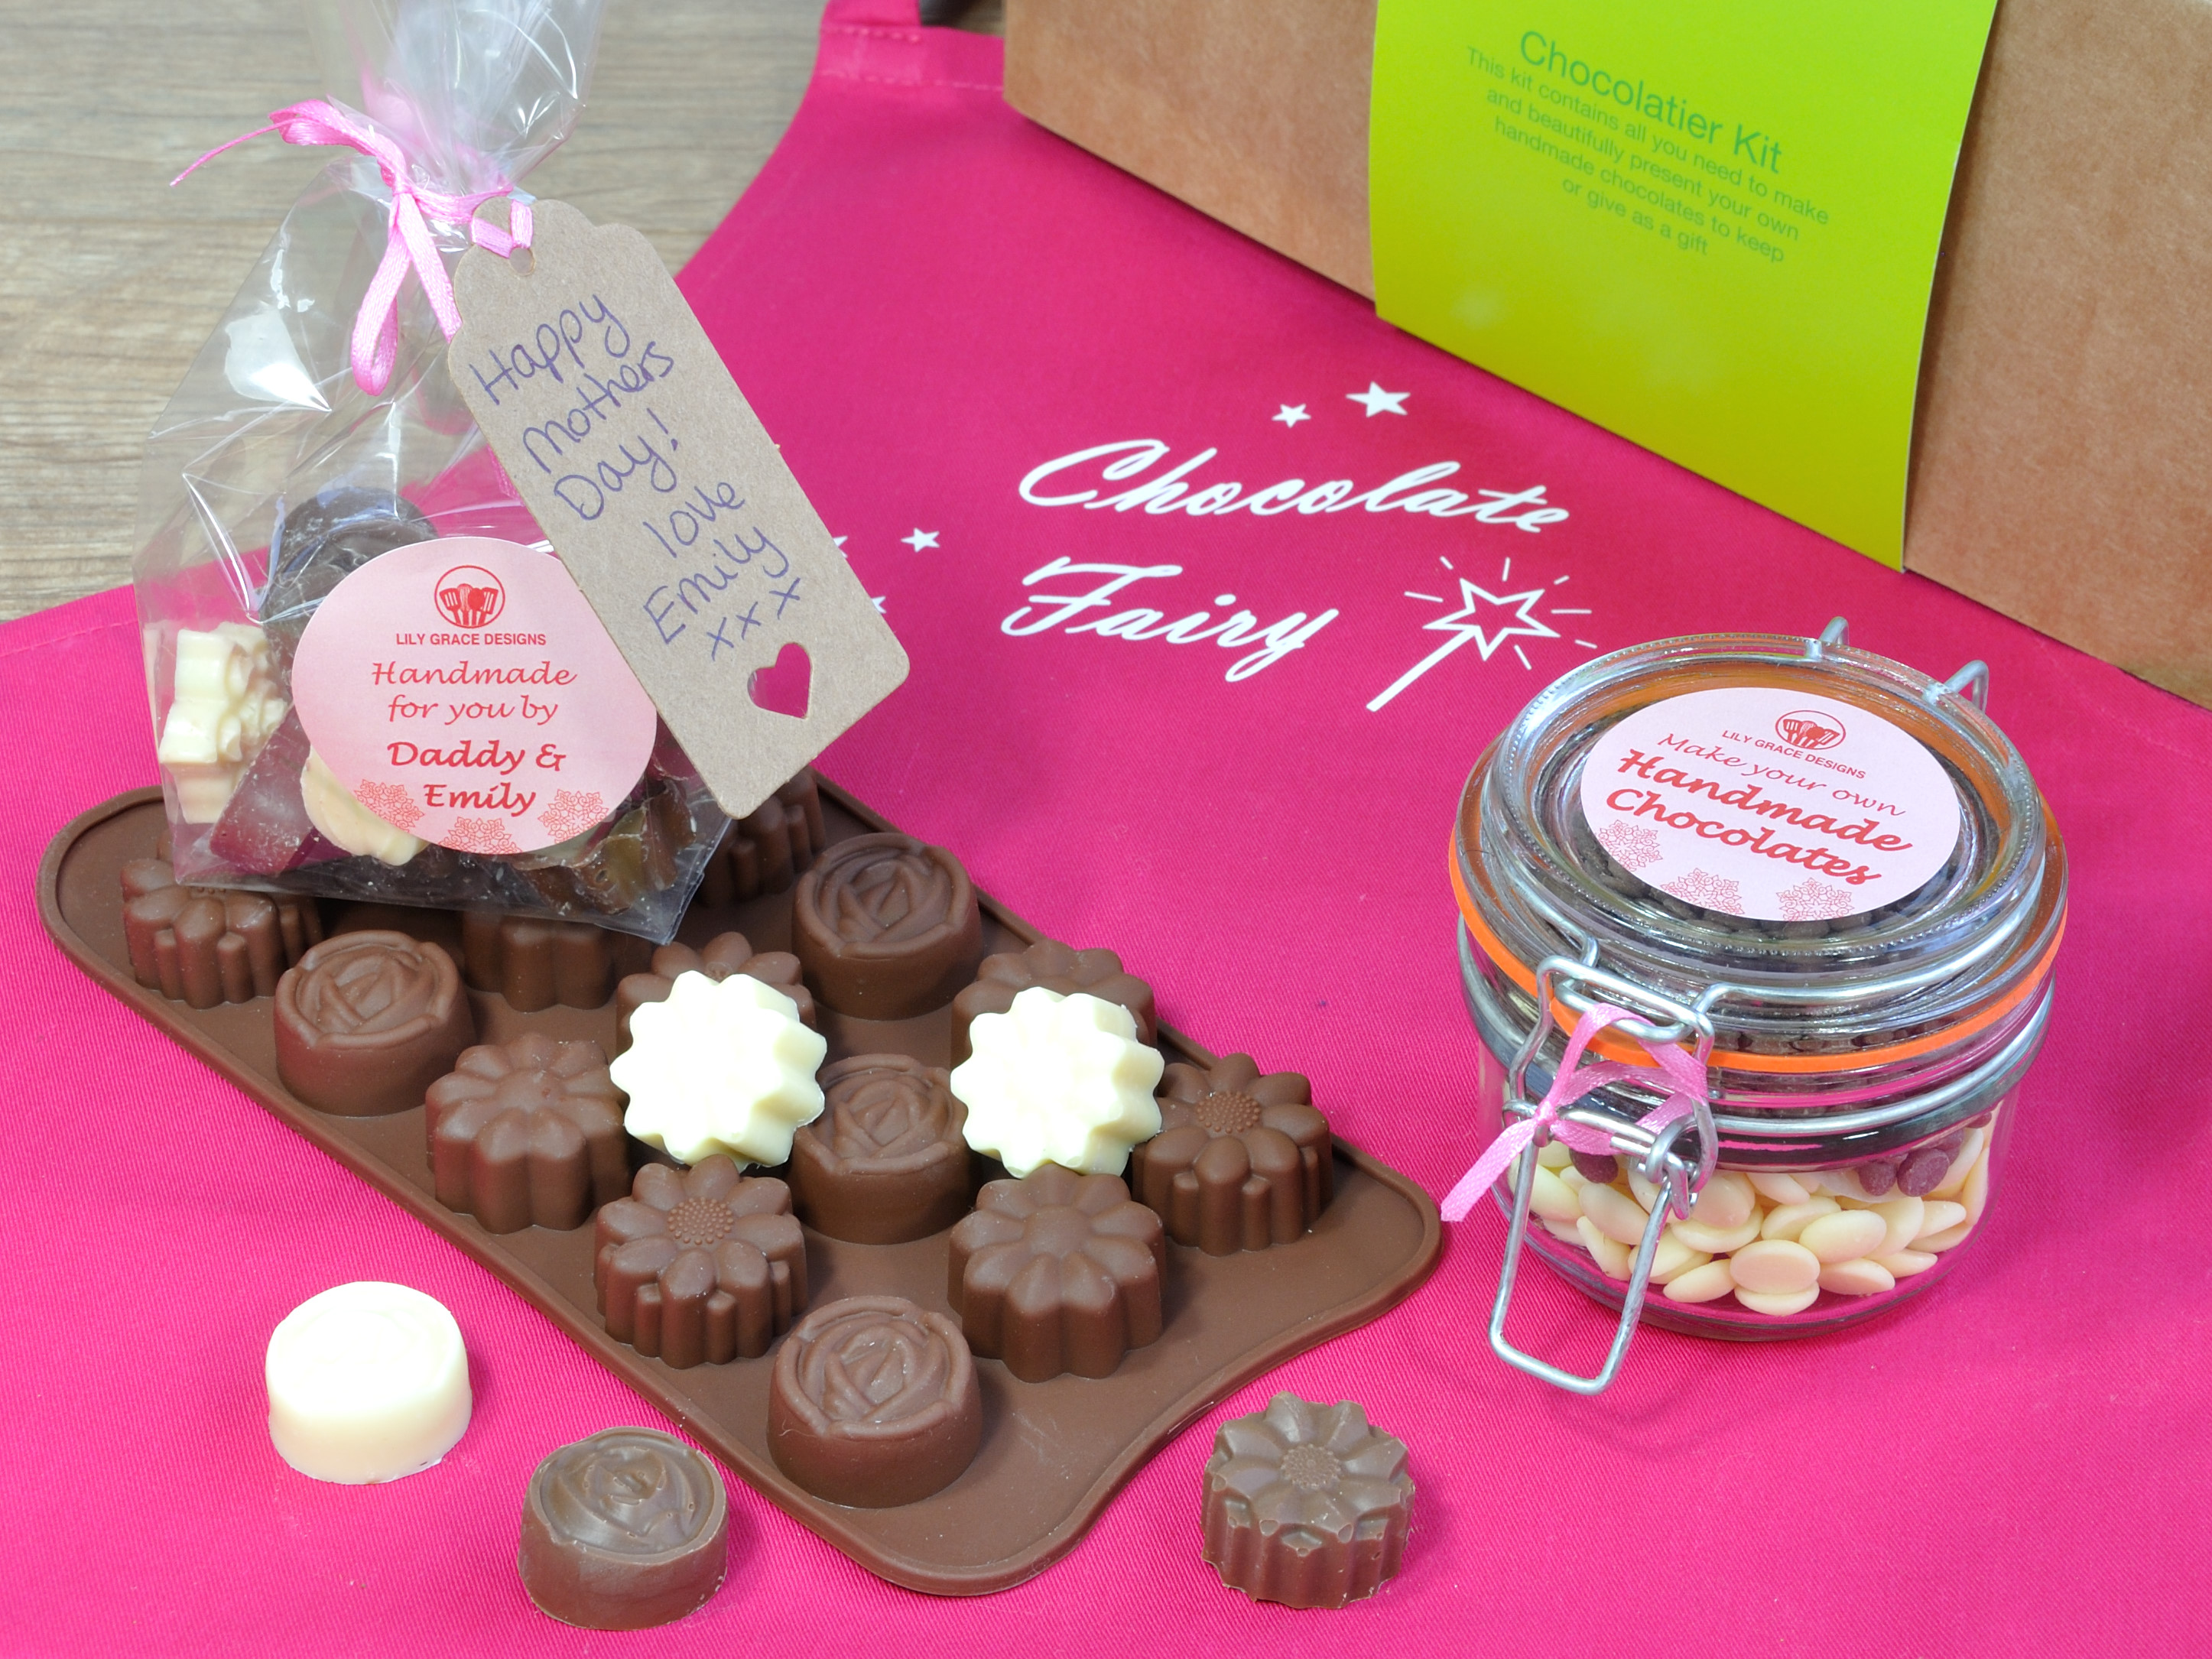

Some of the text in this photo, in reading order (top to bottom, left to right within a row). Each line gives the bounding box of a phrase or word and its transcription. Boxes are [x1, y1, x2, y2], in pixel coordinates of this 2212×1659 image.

[1467, 44, 1829, 225] This kit contains all you need to make
[1520, 31, 1782, 174] Chocolatier Kit
[1486, 88, 1800, 240] and beautifully present your own
[1494, 115, 1785, 263] handmade chocolates to keep
[1562, 178, 1708, 256] or give as a gift
[469, 294, 630, 406] Happy
[553, 407, 679, 521] Day!
[1018, 438, 1570, 532] Chocolate
[642, 526, 789, 644] Emily
[1000, 556, 1340, 682] Fairy
[371, 660, 578, 686] Handmade
[395, 633, 547, 646] LILY GRACE DESIGNS
[386, 739, 567, 776] Daddy &
[388, 694, 559, 726] for you by
[1722, 729, 1867, 781] LILY GRACE DESIGNS
[423, 781, 537, 818] Emily
[1616, 748, 1913, 852] Handmade
[1657, 732, 1907, 817] Make your own
[1605, 787, 1882, 887] Chocolates
